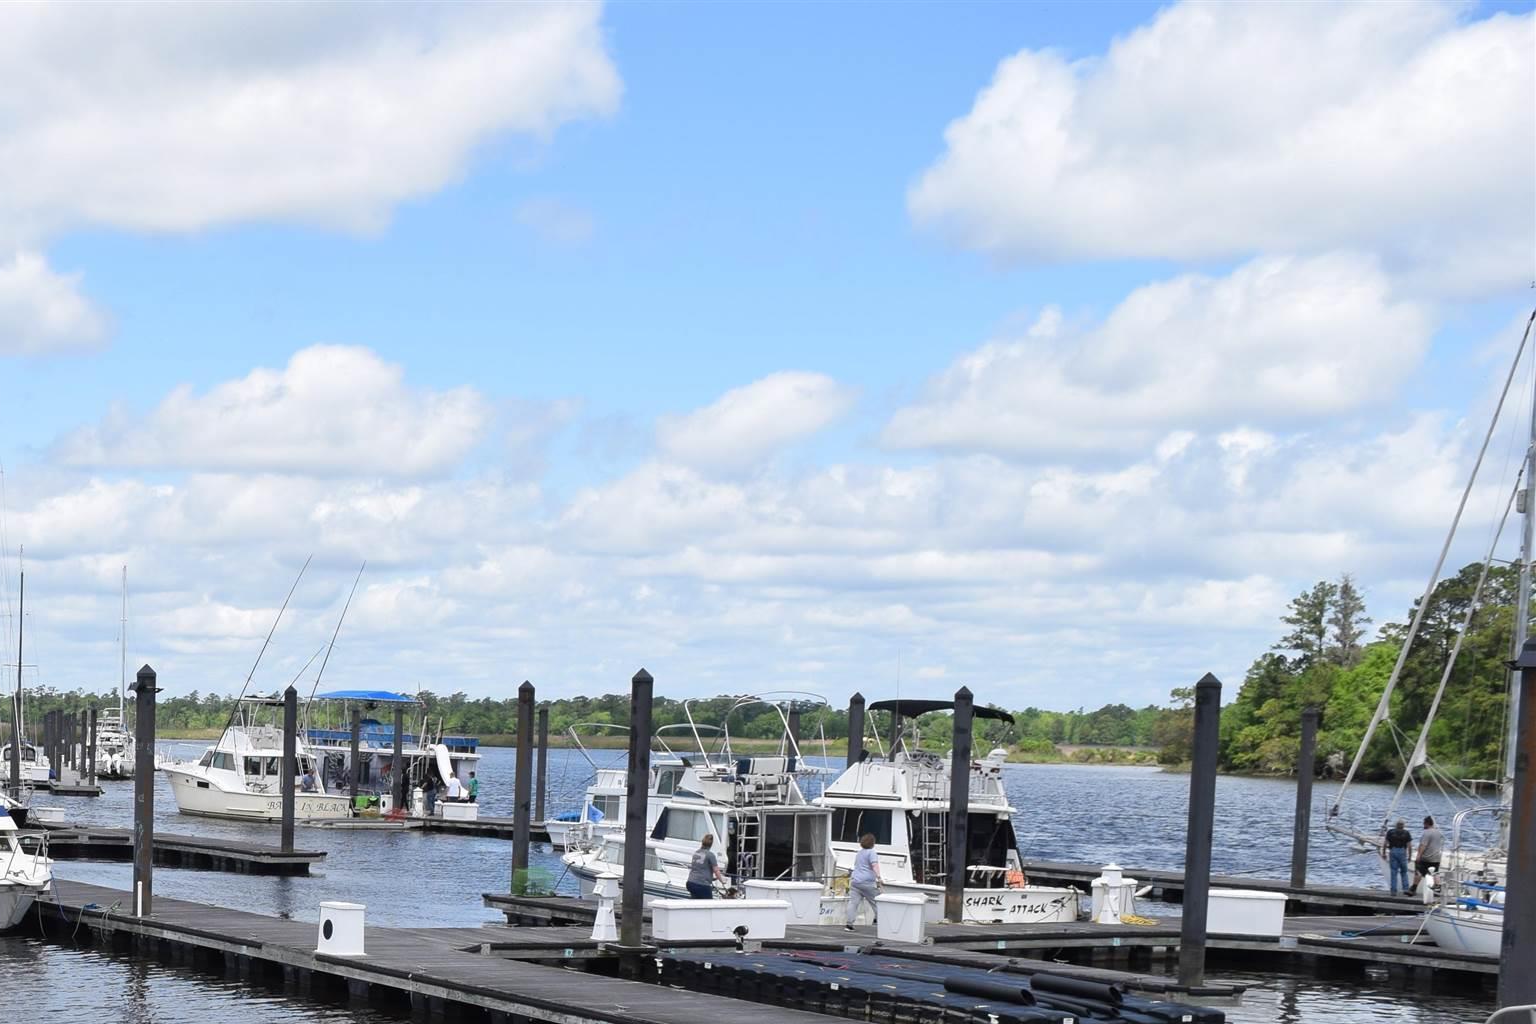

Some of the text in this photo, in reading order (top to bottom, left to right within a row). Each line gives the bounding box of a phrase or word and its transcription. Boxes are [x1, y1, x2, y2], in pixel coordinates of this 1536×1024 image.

[301, 802, 312, 811] IN
[316, 803, 348, 812] BLACK
[966, 895, 1004, 907] SHARK
[1010, 903, 1048, 914] ATTACK
